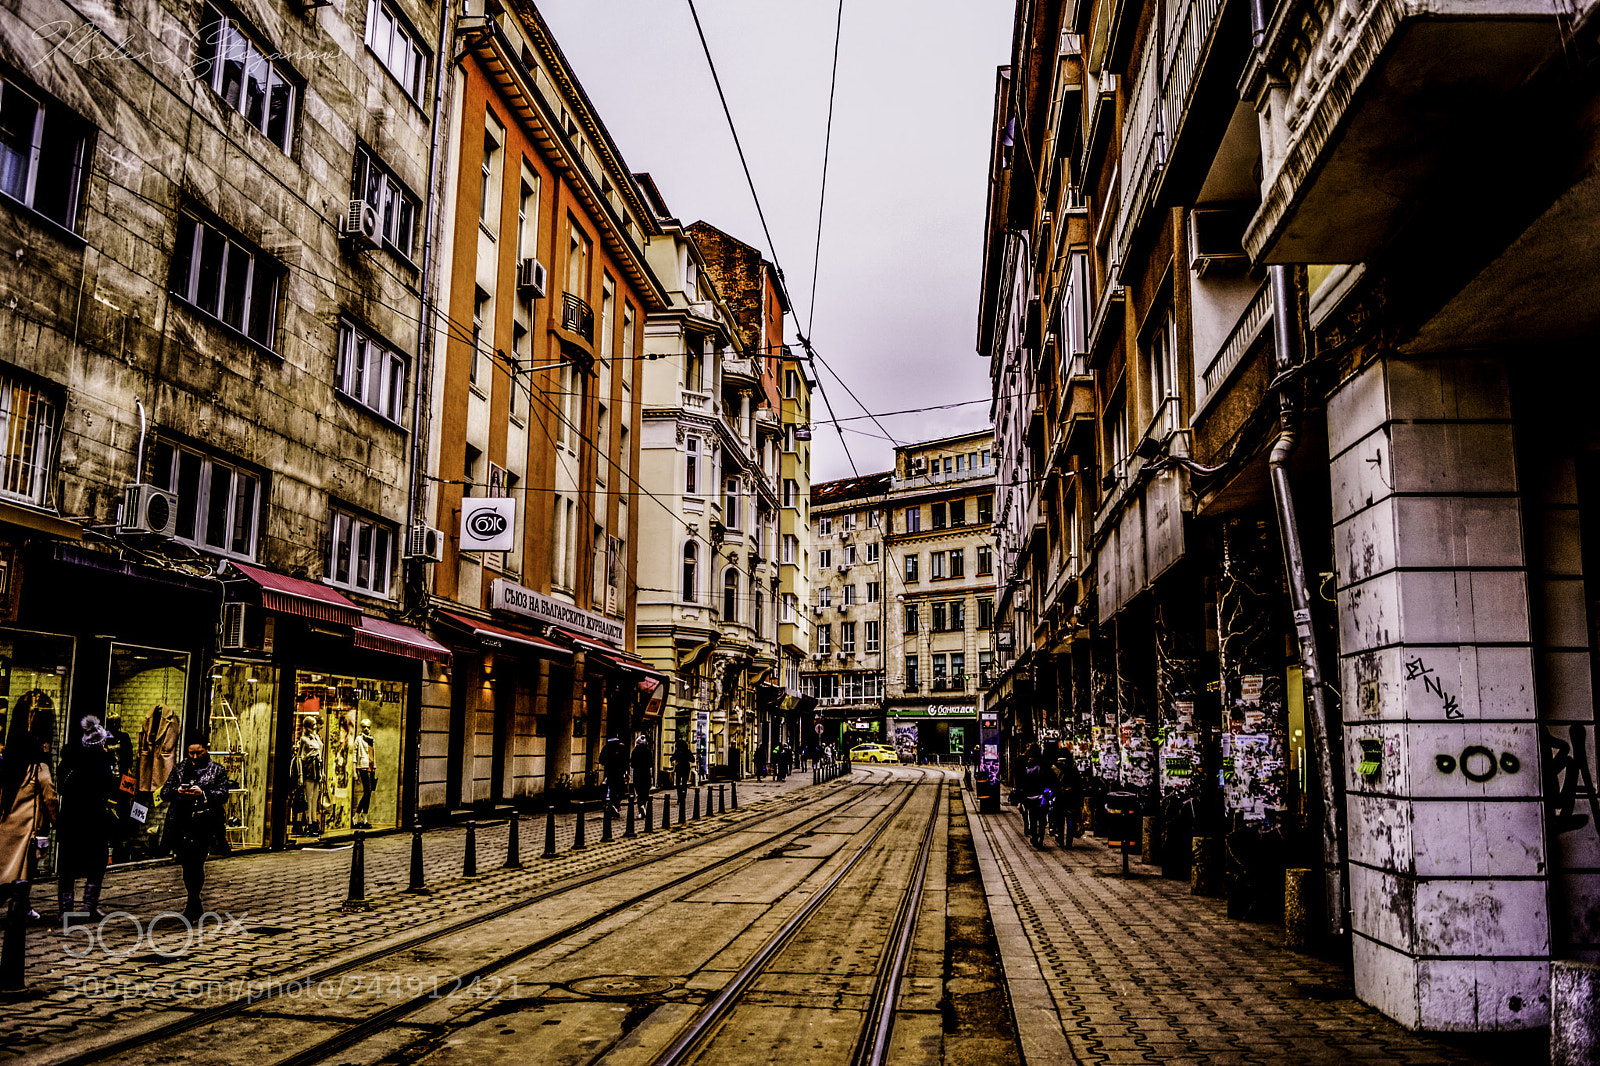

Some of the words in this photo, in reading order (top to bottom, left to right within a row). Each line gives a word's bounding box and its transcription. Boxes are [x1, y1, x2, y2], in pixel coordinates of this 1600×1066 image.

[504, 587, 528, 609] СЪЮЗ
[529, 595, 540, 613] НА
[541, 599, 586, 628] БЪЛГАРСКИТЕ
[586, 615, 623, 640] ЖУРНАЛИСТИ
[960, 705, 975, 714] ДСК
